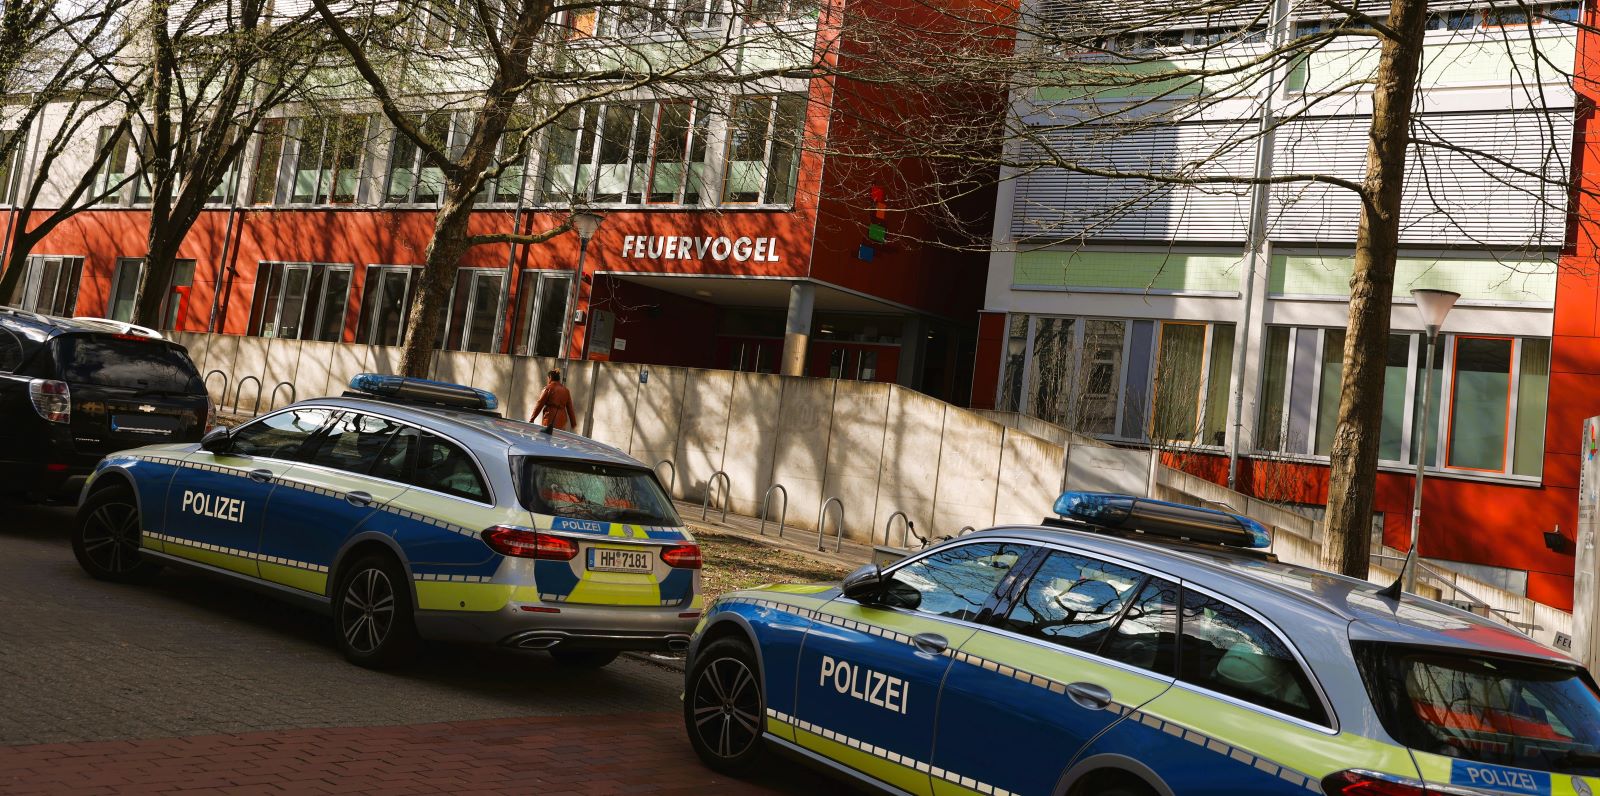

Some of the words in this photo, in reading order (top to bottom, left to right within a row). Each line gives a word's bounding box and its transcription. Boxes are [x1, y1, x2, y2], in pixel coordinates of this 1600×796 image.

[621, 235, 780, 262] FEUERVOGEL
[182, 489, 246, 524] POLIZEI
[562, 520, 601, 532] POLIZEI
[601, 552, 615, 567] HH
[622, 553, 647, 568] 7181
[819, 655, 910, 715] POLIZEI
[1466, 767, 1538, 791] POLIZEI
